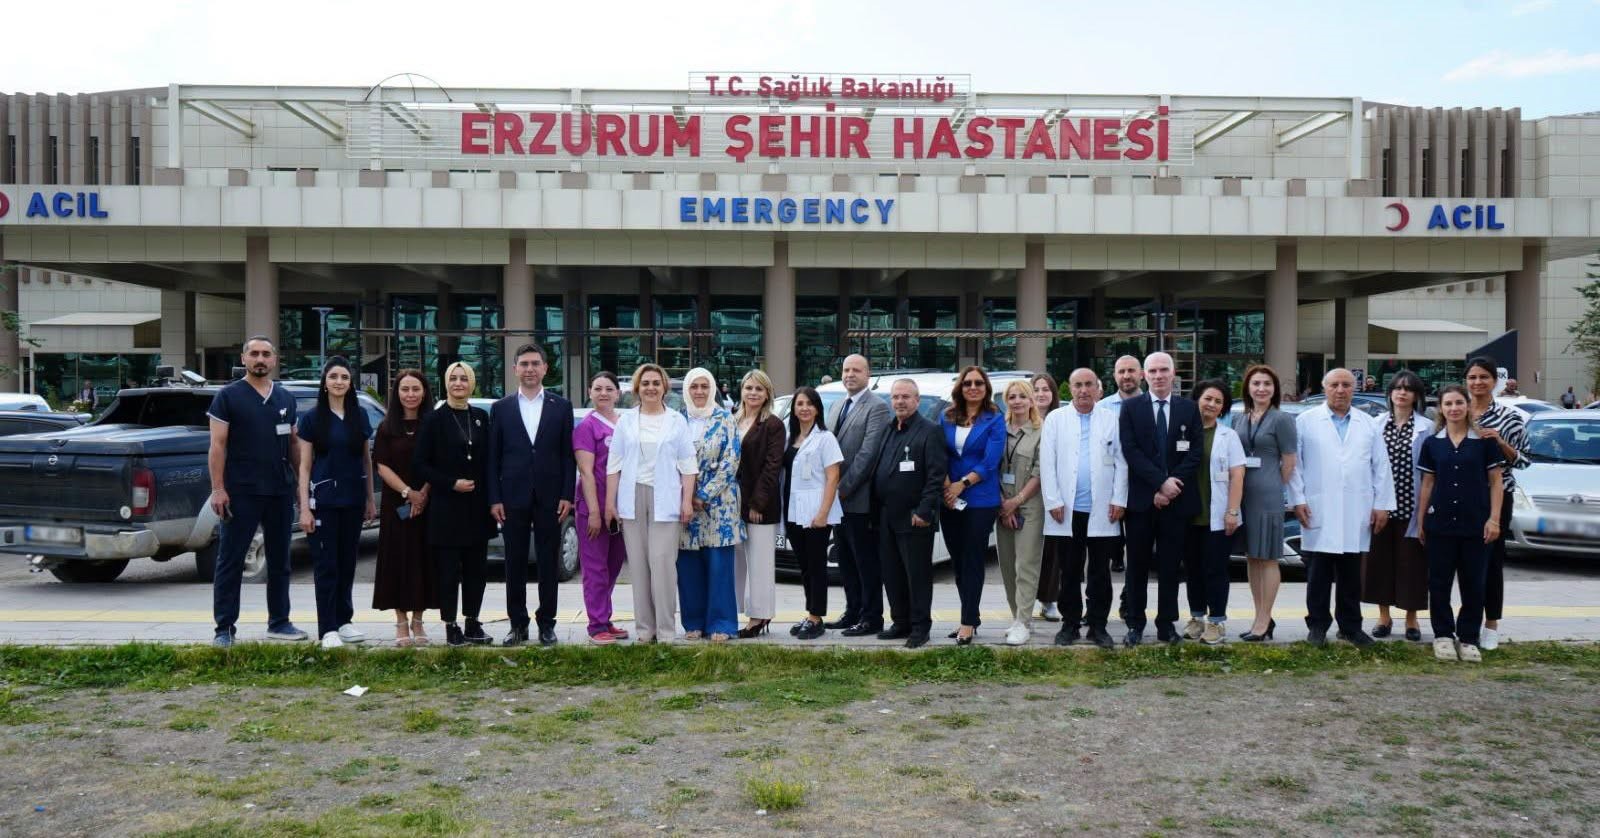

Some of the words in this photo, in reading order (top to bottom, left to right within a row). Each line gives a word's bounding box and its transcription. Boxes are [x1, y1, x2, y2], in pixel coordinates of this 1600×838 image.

[757, 74, 832, 101] Sağlık
[842, 76, 953, 102] Bakanlığı
[461, 112, 701, 157] ERZURUM
[725, 103, 871, 163] ŞEHİR
[893, 106, 1169, 161] HASTANESİ
[680, 197, 895, 225] EMERGENCY
